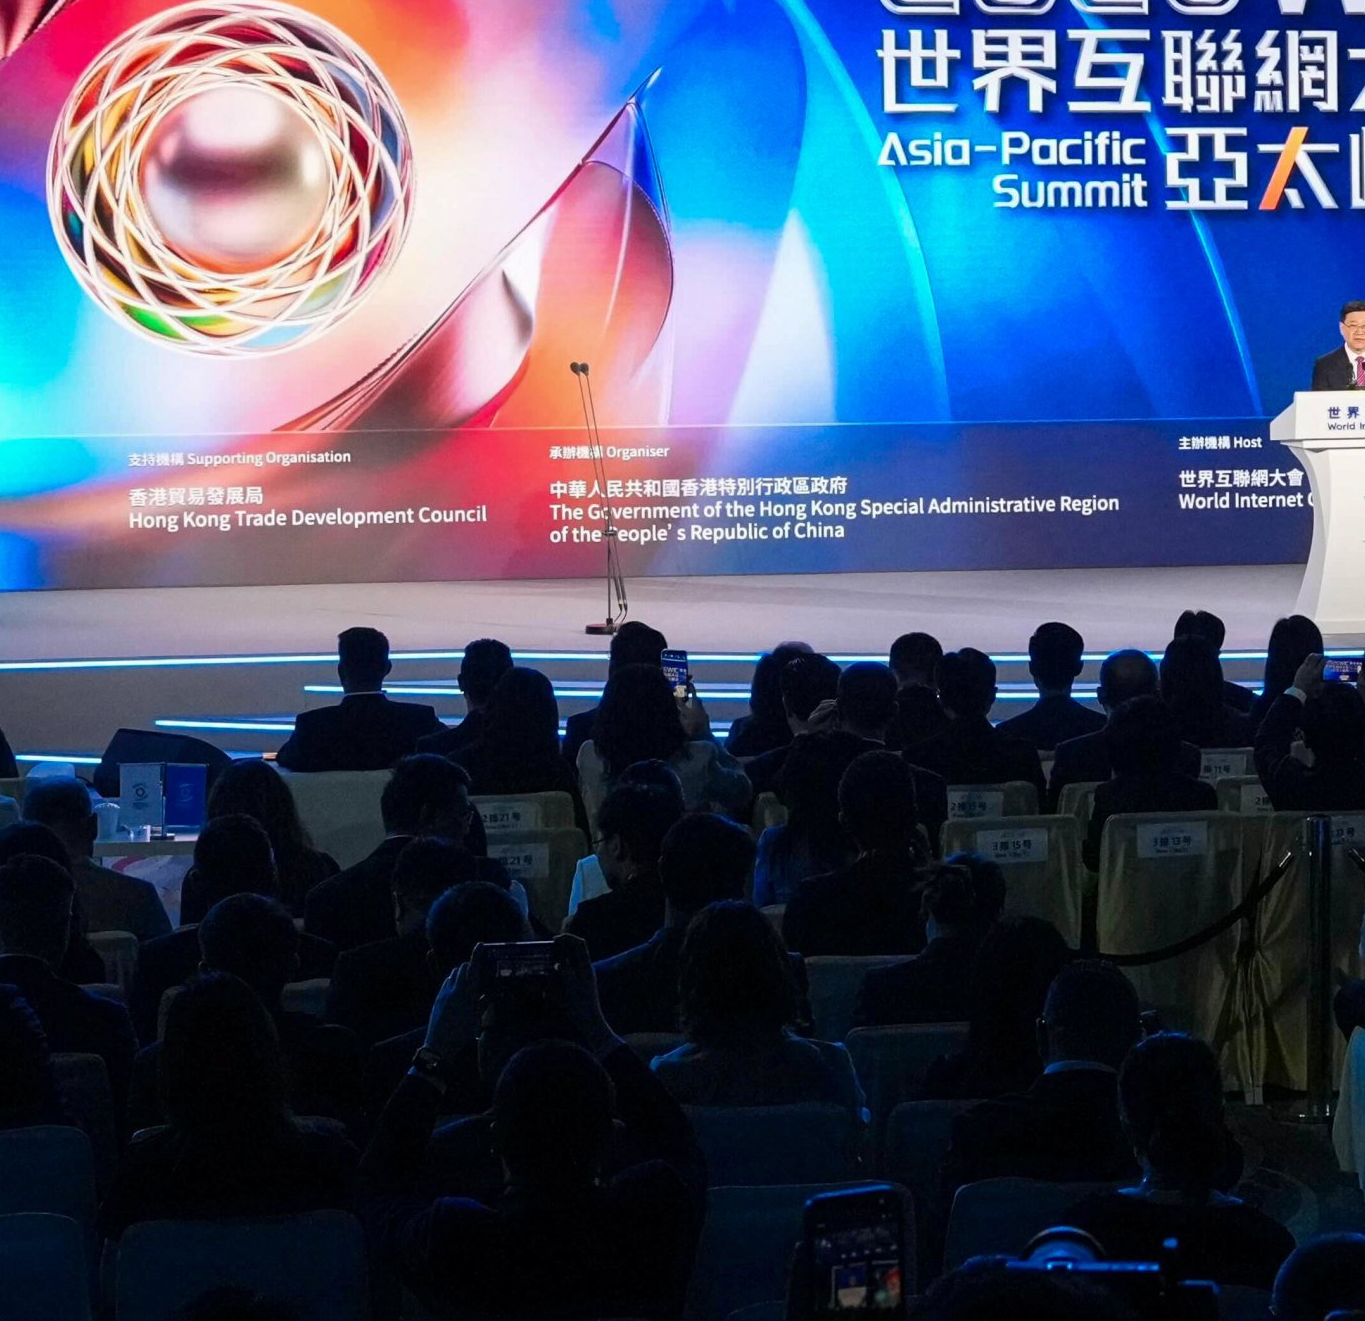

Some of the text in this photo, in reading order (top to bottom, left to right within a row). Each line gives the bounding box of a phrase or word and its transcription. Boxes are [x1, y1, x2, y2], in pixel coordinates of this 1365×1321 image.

[878, 131, 1145, 165] Asia-Pacific
[993, 174, 1147, 207] Summit
[607, 445, 669, 460] Organiser
[1234, 437, 1262, 448] Host
[187, 451, 263, 466] Supporting
[265, 450, 351, 465] Organisation
[550, 476, 848, 498] 中華人民共和國香港特別行政區政府
[1179, 468, 1304, 488] 世界互聯網大會
[129, 487, 263, 506] 香港貿易發展局
[1179, 492, 1229, 509] World
[1235, 493, 1303, 508] Internet
[550, 504, 583, 520] The
[704, 501, 722, 517] of
[725, 501, 755, 517] the
[760, 501, 807, 520] Hong
[812, 500, 856, 519] Kong
[861, 498, 923, 518] Special
[928, 496, 1055, 513] Administrative
[1061, 495, 1119, 515] Region
[129, 505, 486, 532] Hong Kong Trade Development Council
[550, 526, 568, 543] of
[572, 526, 601, 542] the
[691, 523, 768, 543] Republic
[773, 522, 791, 538] of
[794, 522, 844, 538] China
